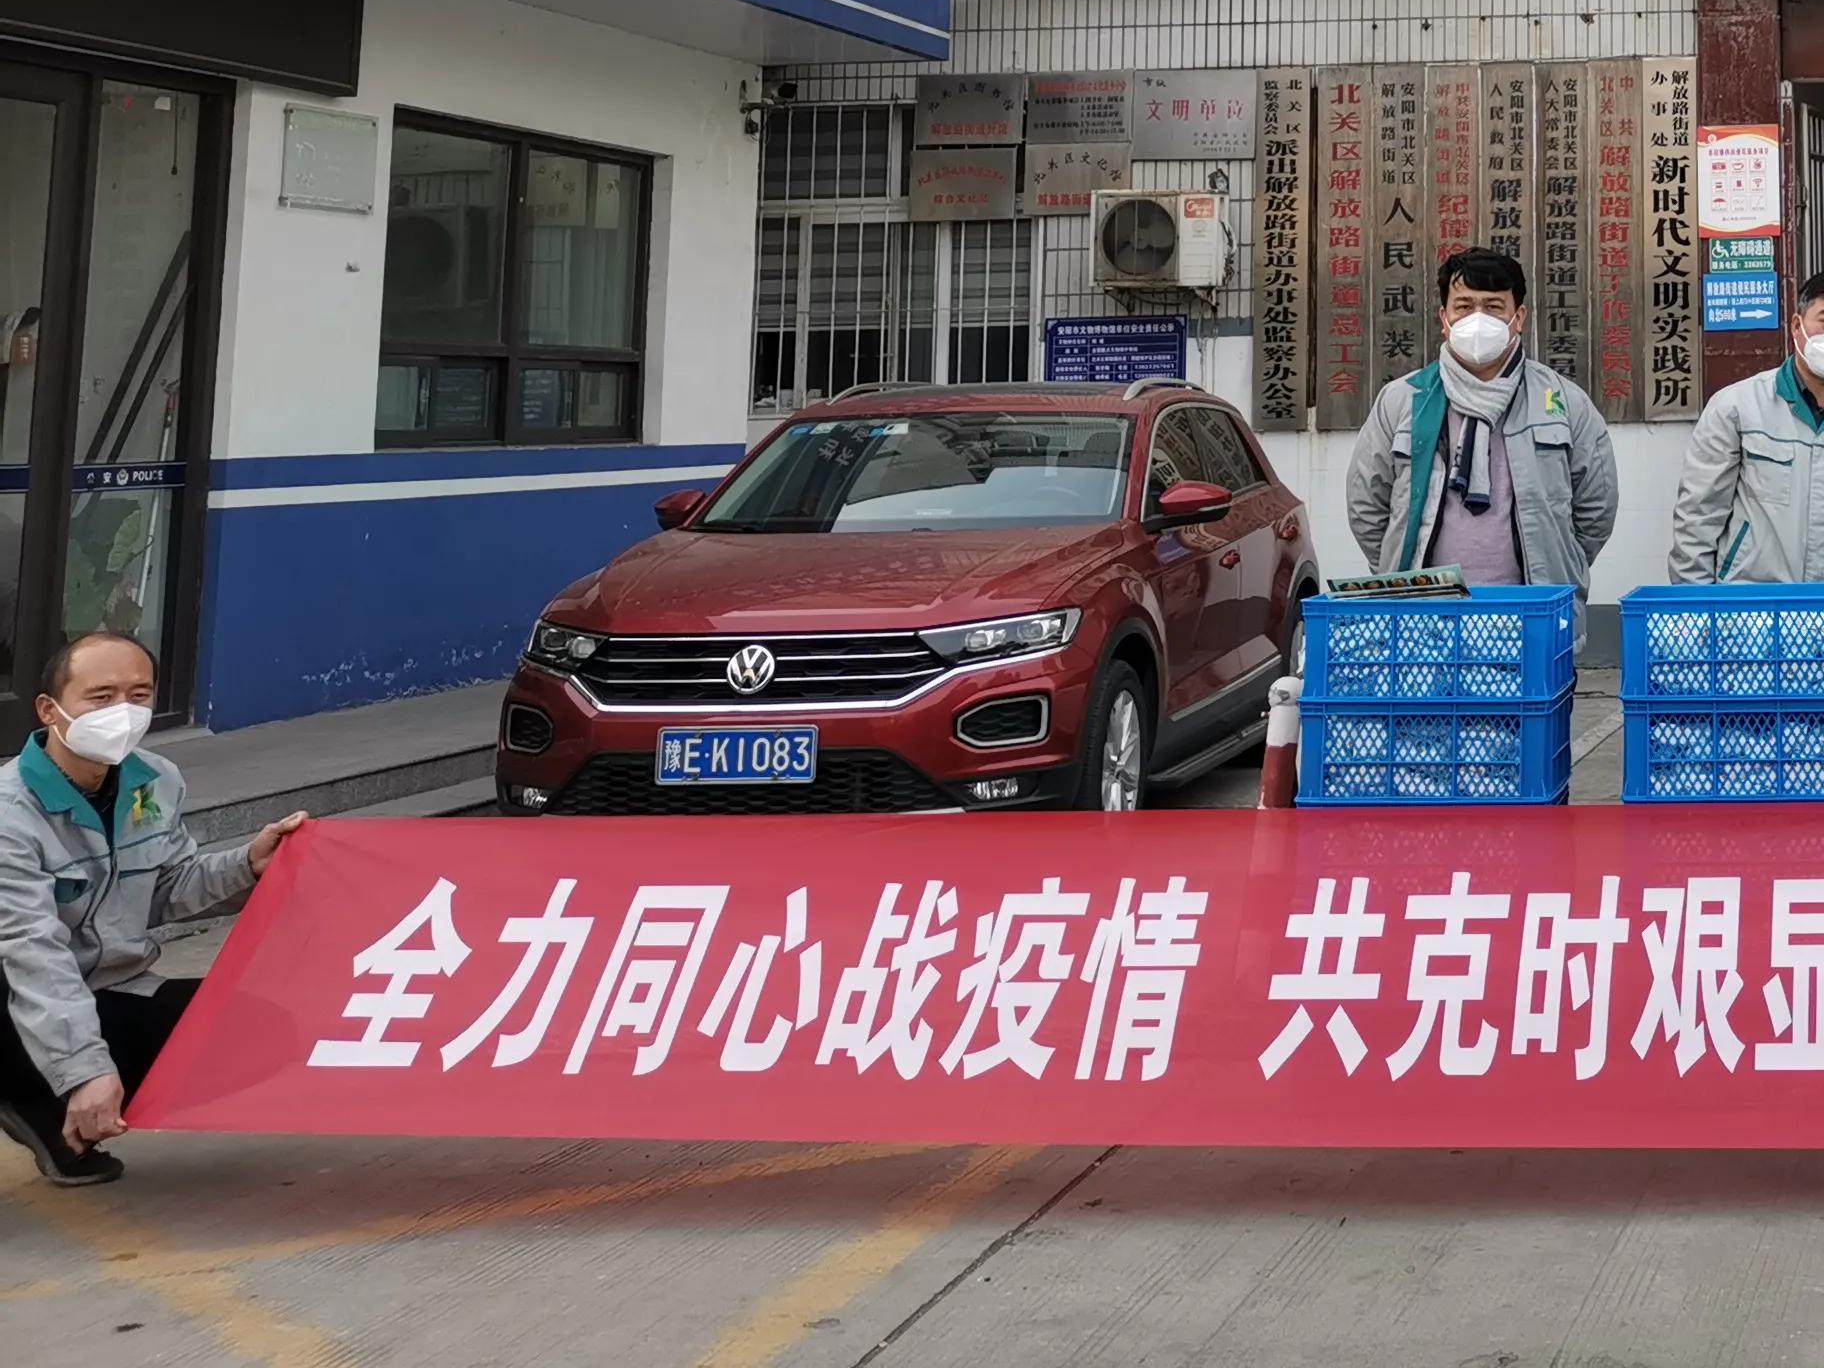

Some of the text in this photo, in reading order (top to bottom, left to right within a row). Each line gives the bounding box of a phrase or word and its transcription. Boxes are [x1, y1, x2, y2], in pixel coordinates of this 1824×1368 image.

[1145, 99, 1245, 121] 文明单位
[1264, 79, 1280, 135] 监察委员会
[1286, 79, 1303, 134] 北关区
[1381, 82, 1396, 185] 解放路街道
[1401, 82, 1416, 185] 安阳市北关区
[1488, 82, 1505, 171] 人民政府
[1510, 79, 1525, 171] 安阳市北关区
[1545, 79, 1560, 170] 人大常委会
[1563, 78, 1578, 171] 安阳市北关区
[1650, 70, 1668, 147] 办事处
[1672, 70, 1690, 146] 解放路街道
[1262, 139, 1299, 419] 派出解放路街道办事处监察办公室
[1328, 82, 1364, 394] 北关区解放路街道总工会
[1599, 145, 1633, 401] 解放路街道工作委员会
[1651, 154, 1692, 407] 新时代文明实践所
[1382, 197, 1415, 384] 人民武装
[306, 875, 1209, 1083] 全力同心战疫情
